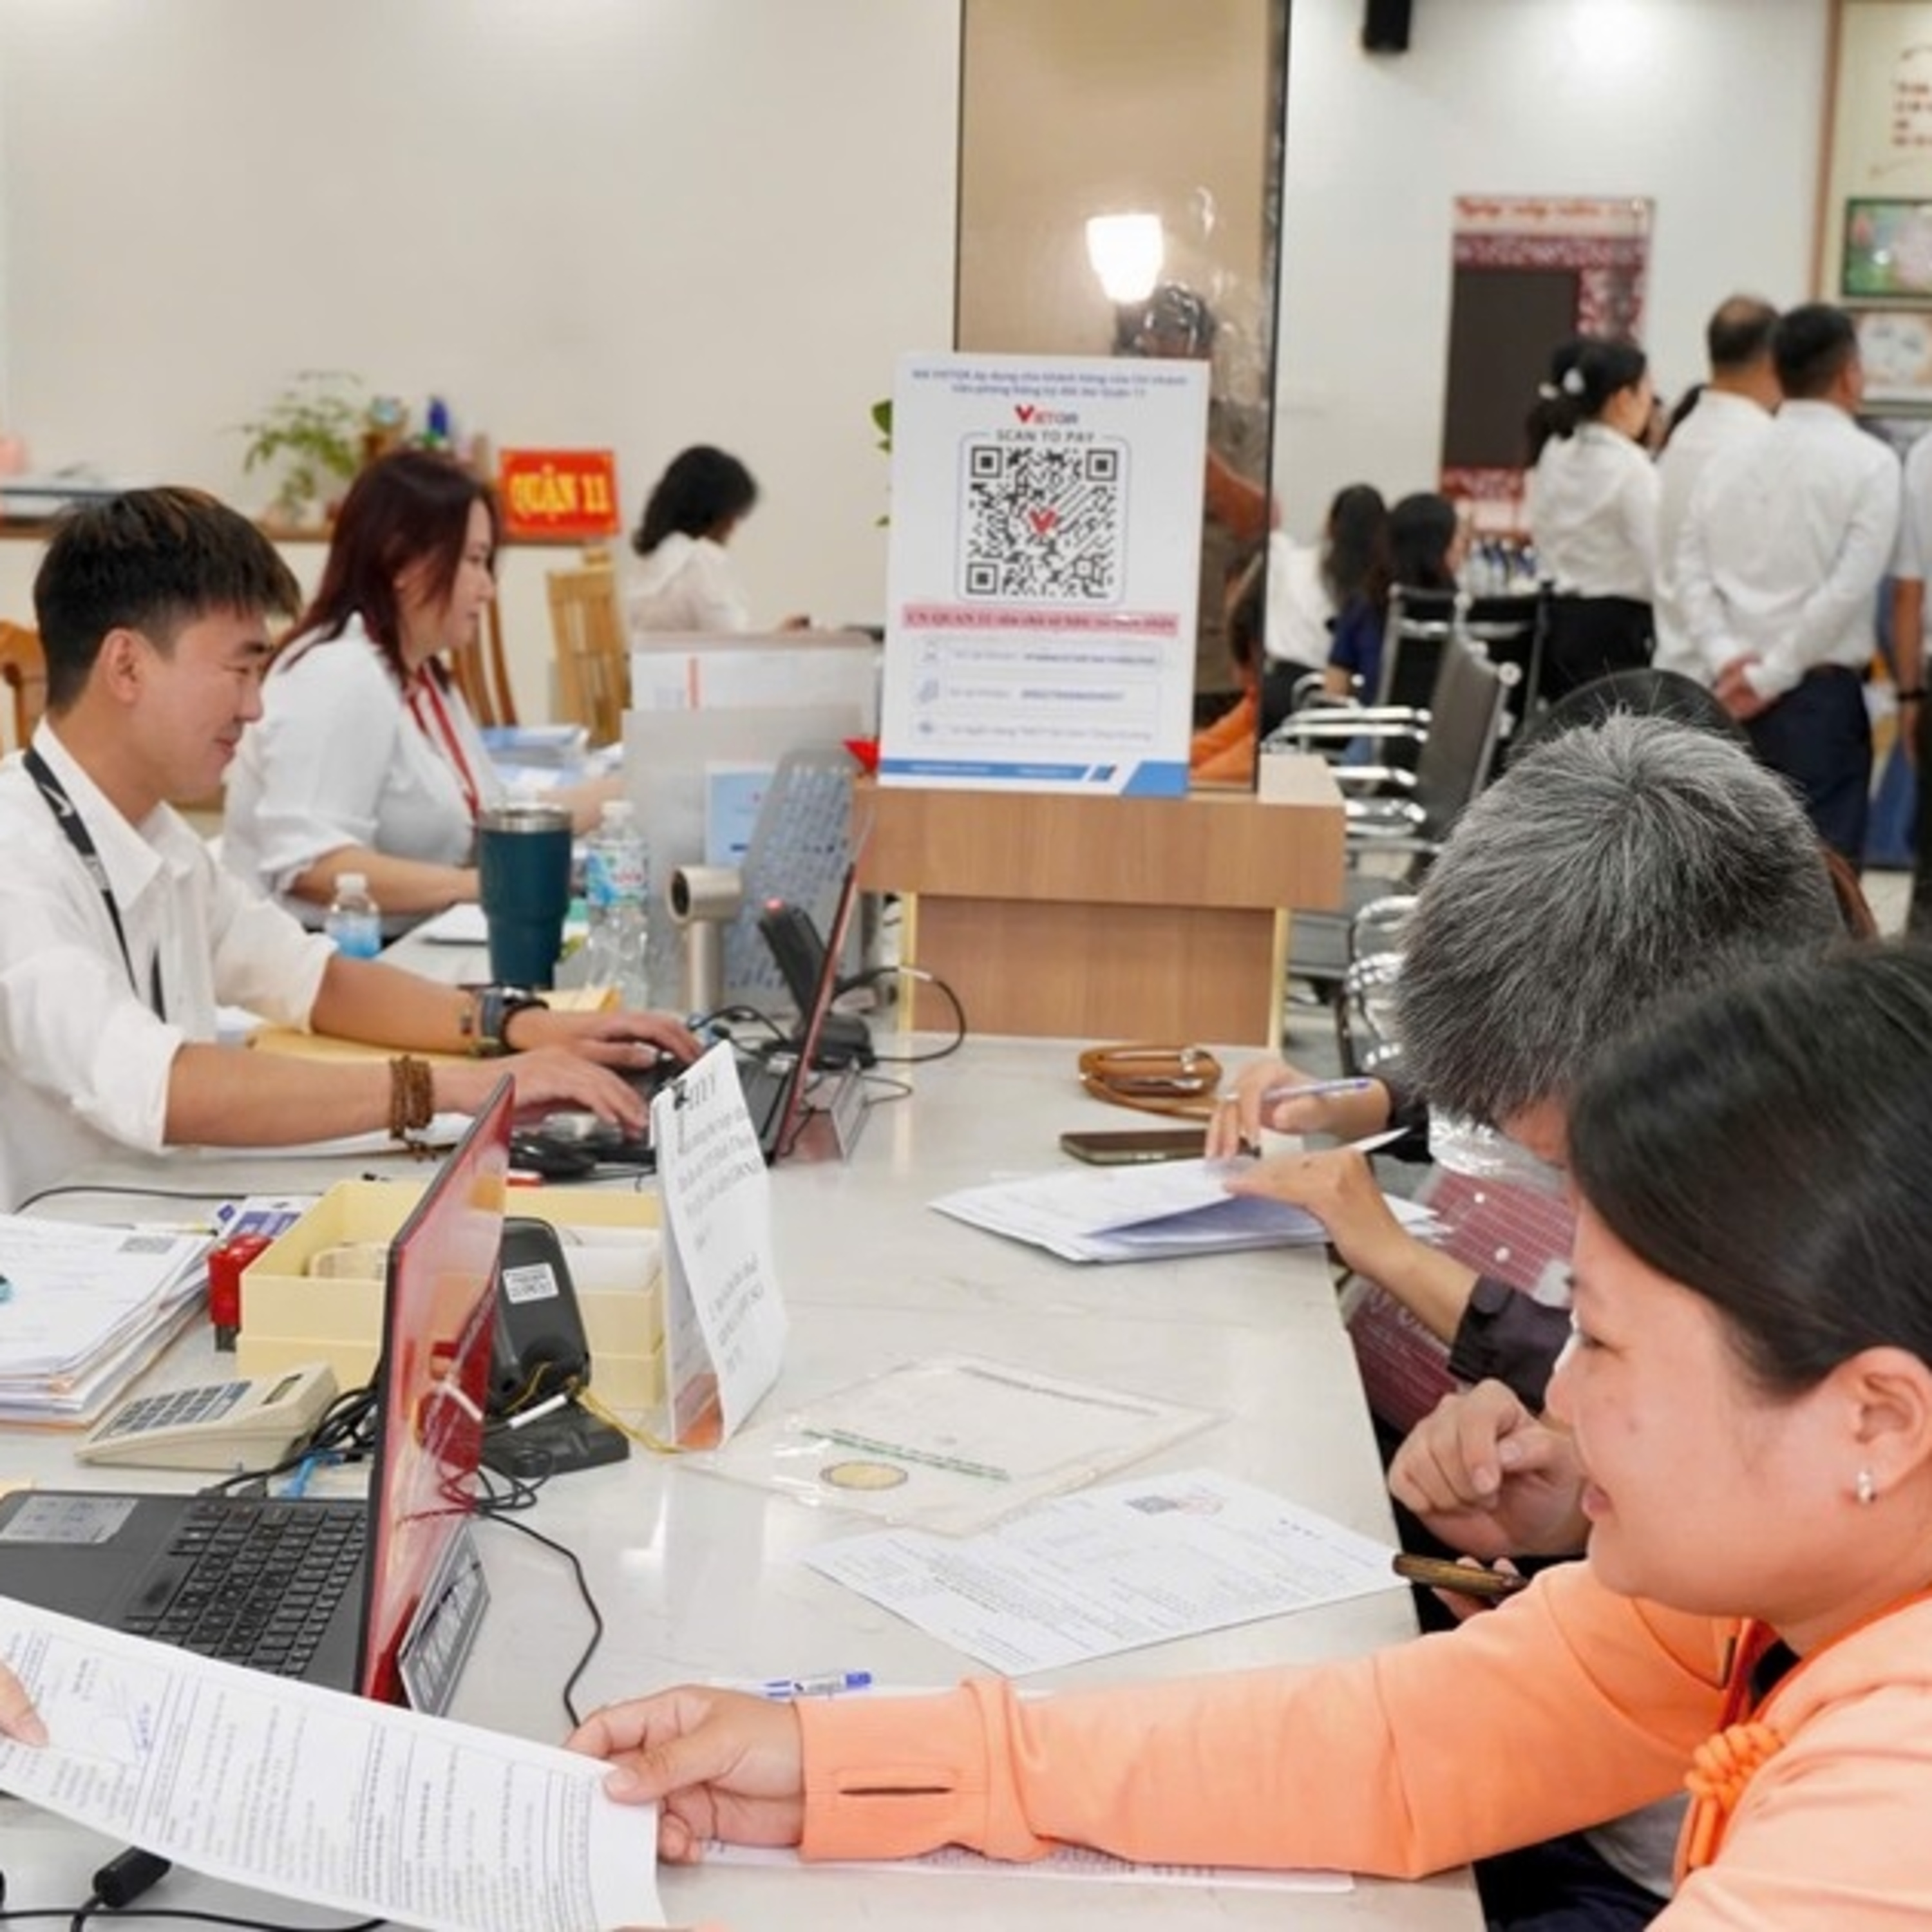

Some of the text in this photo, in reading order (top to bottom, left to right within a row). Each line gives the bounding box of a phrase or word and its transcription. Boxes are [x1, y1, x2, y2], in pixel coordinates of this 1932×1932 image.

[996, 430, 1095, 442] SCAN TO PAY
[509, 462, 608, 523] QUẬN 11
